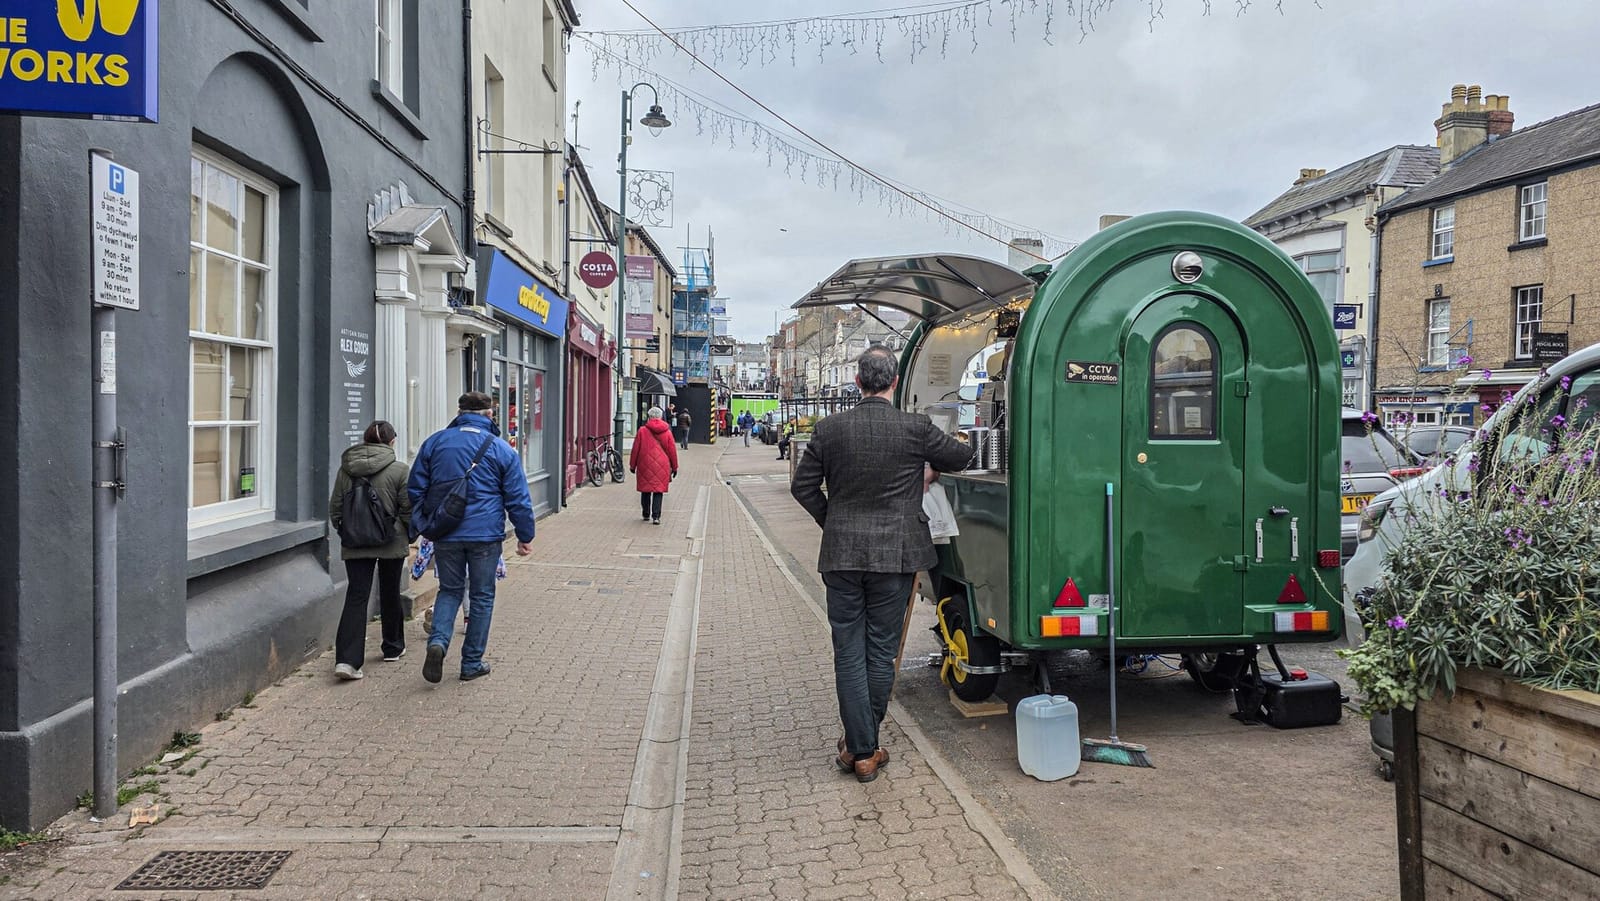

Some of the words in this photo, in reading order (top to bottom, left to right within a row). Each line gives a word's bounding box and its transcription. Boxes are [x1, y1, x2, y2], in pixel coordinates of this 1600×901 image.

[113, 169, 122, 190] P
[120, 197, 131, 208] Sad
[106, 212, 115, 223] 30
[96, 221, 107, 232] Dim
[104, 248, 116, 260] Mon
[121, 253, 131, 263] Sat
[582, 263, 614, 272] COSTA
[106, 270, 115, 280] 30
[116, 272, 129, 283] mins
[104, 280, 113, 291] No
[114, 284, 131, 294] return
[99, 291, 118, 302] within
[123, 296, 135, 305] hour
[1088, 365, 1112, 374] CCTV
[1081, 372, 1088, 380] in
